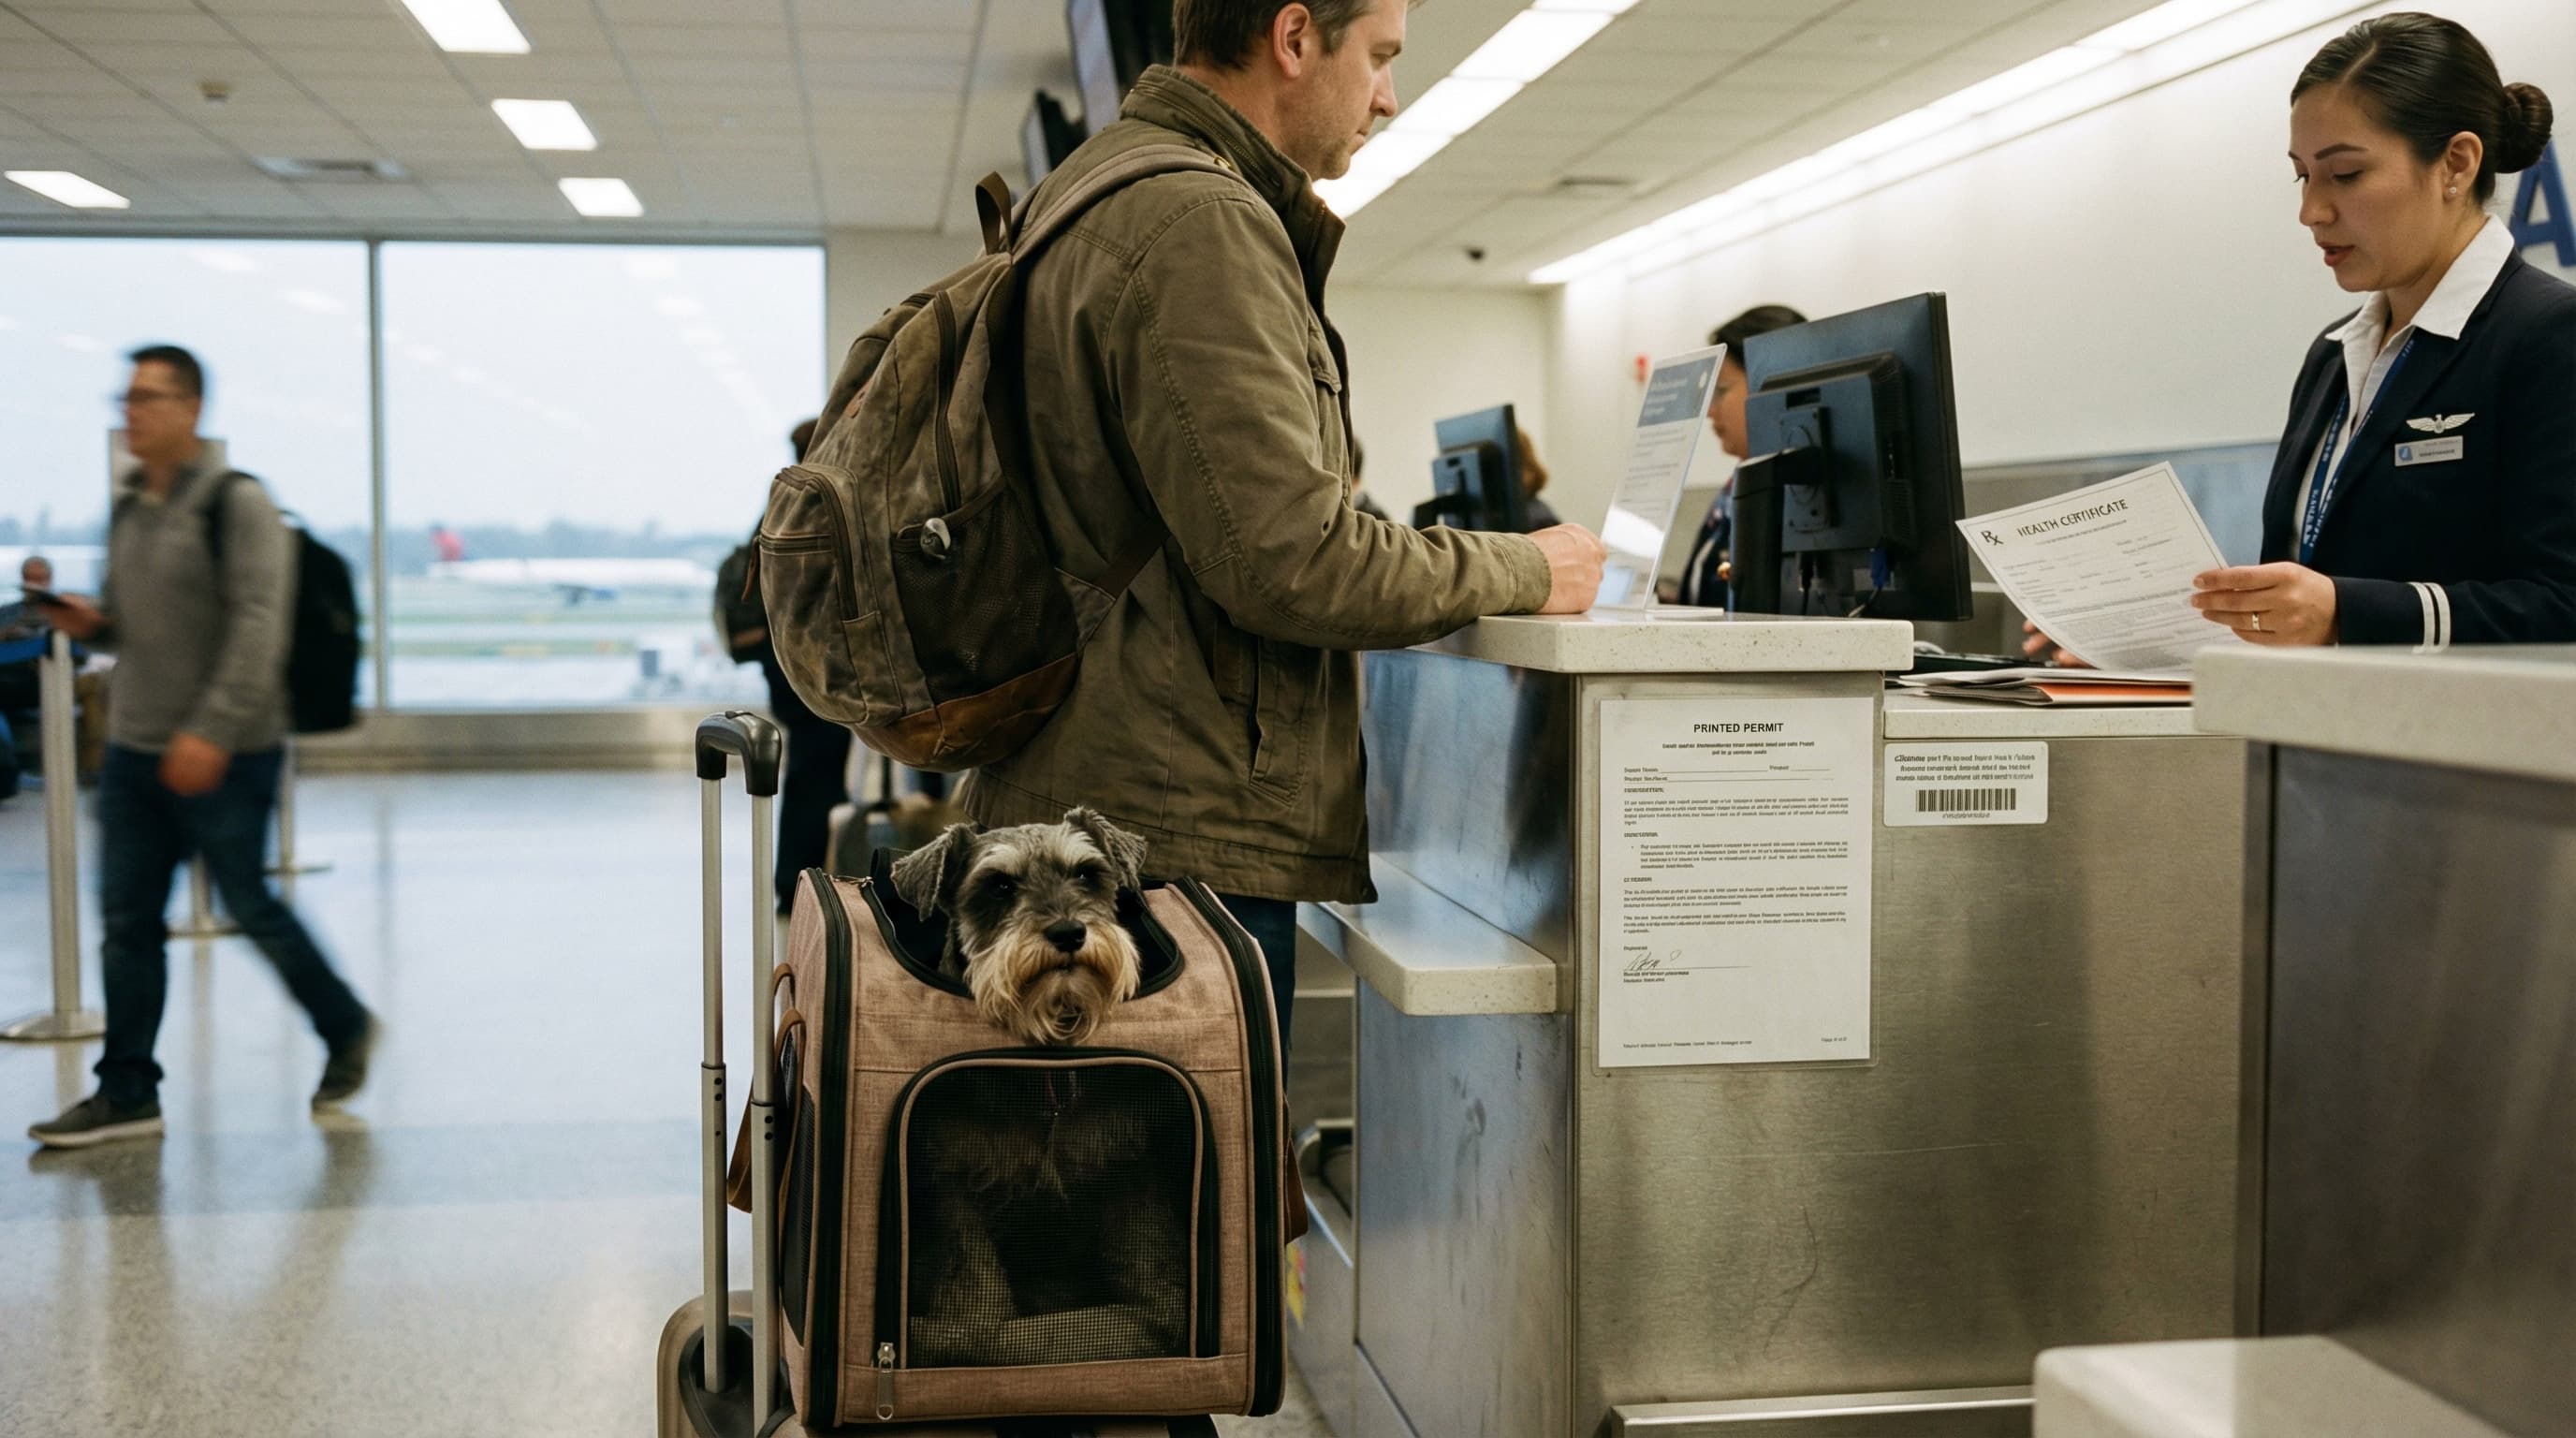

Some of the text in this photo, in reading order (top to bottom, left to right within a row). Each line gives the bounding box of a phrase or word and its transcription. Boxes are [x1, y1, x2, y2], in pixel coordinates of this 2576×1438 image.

[2017, 517, 2059, 537] HEALTH
[2060, 499, 2129, 526] CERTIFICATE
[1693, 723, 1783, 732] PRINTED PERMIT
